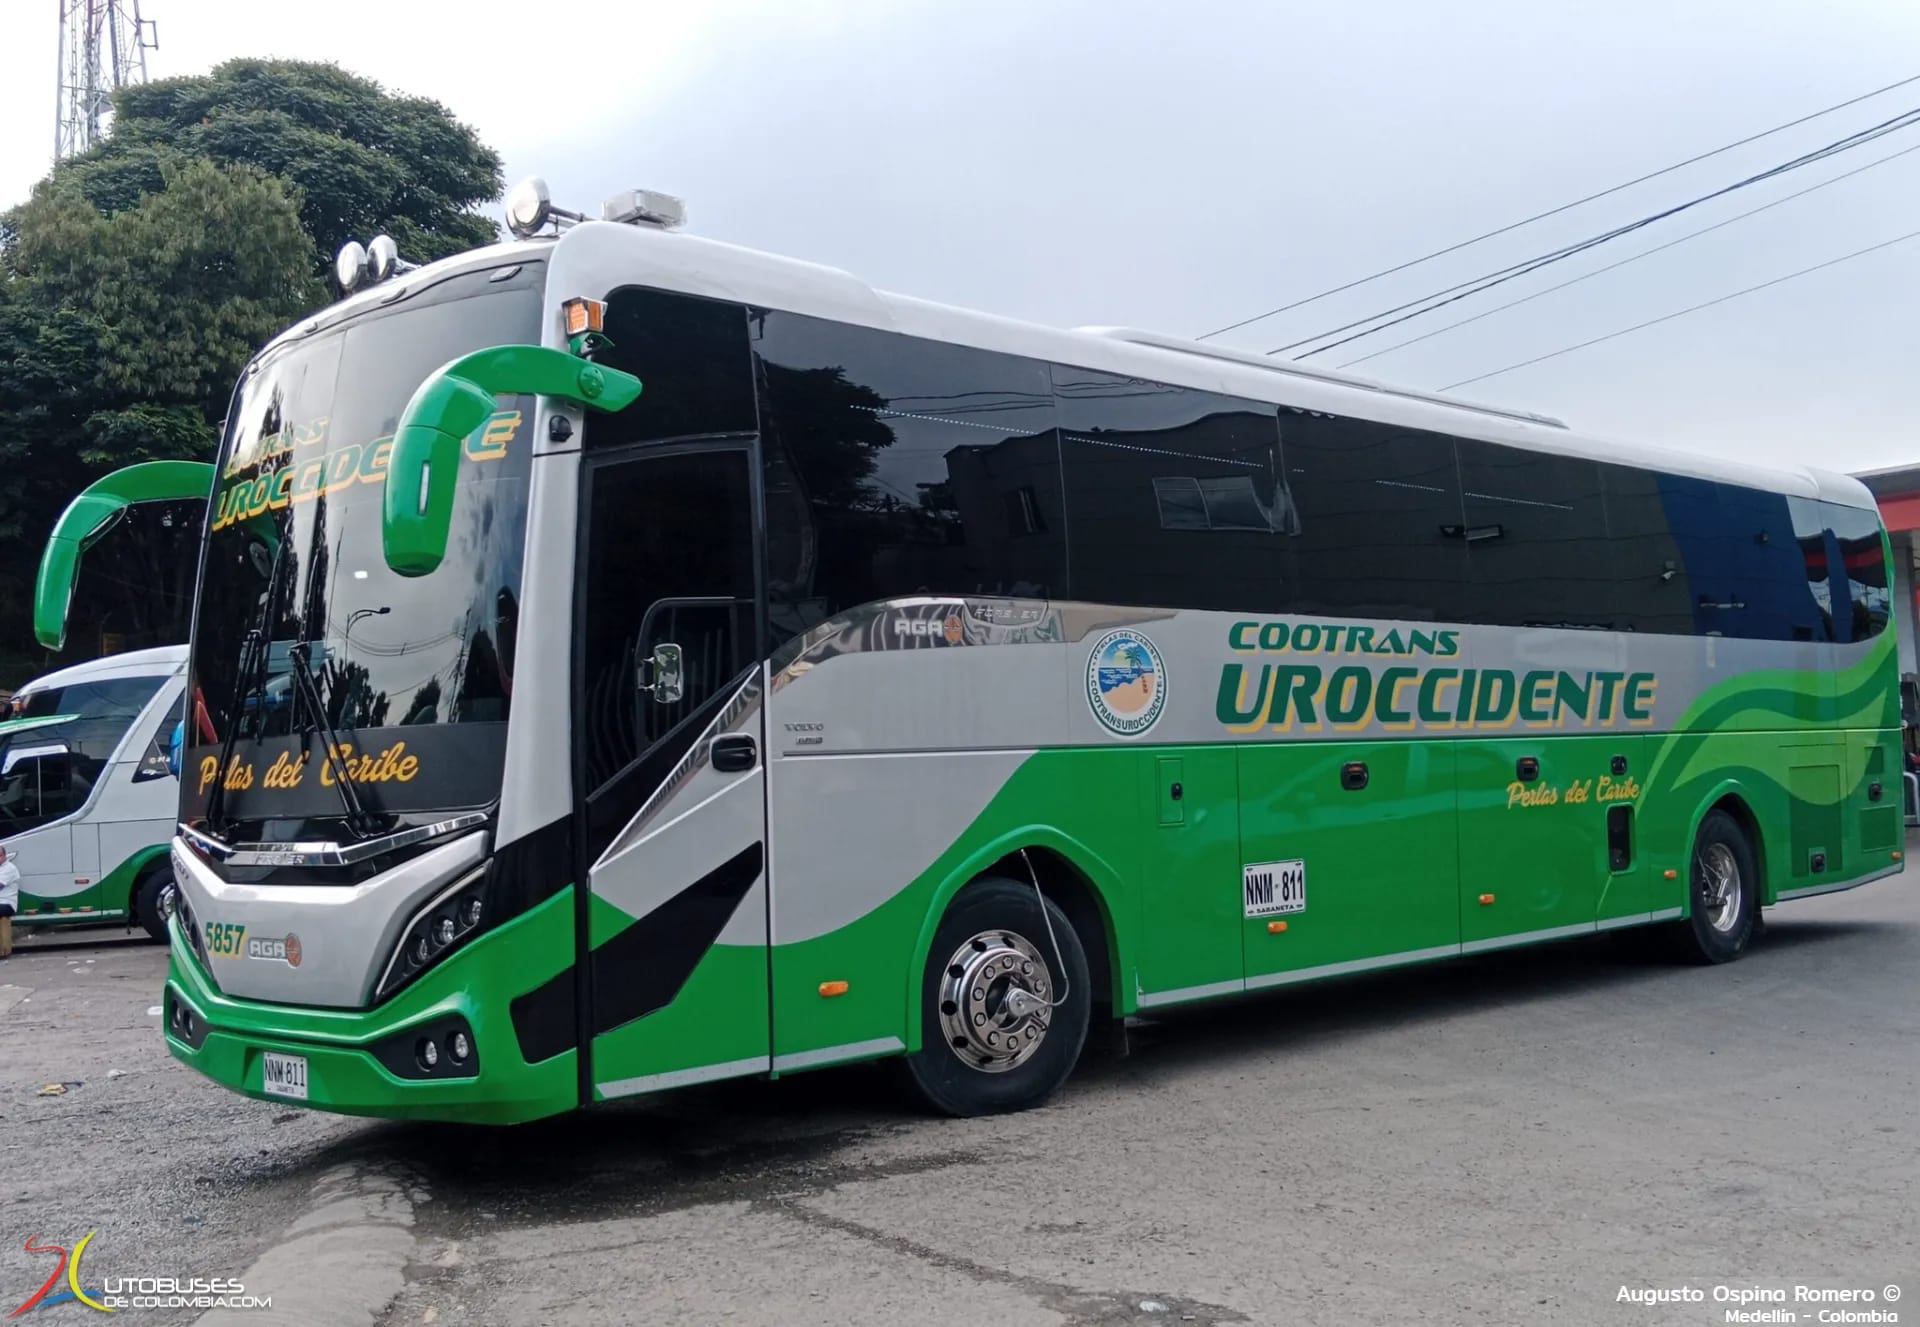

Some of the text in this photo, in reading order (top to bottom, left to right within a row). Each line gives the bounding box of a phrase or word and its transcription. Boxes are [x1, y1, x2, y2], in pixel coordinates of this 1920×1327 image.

[212, 410, 521, 531] UROCCIDEE
[894, 619, 943, 636] AGA
[1229, 621, 1460, 657] COOTRANS
[1091, 679, 1163, 731] COOTRANSUROCCIDENTE
[1216, 663, 1658, 734] UROCCIDENTE
[264, 750, 310, 788] del
[1506, 775, 1640, 810] Perlas del Caribe
[1246, 869, 1303, 906] NNM 811
[1257, 904, 1295, 914] SABANETA
[205, 921, 248, 961] 5857
[249, 940, 287, 958] AGA
[265, 1059, 305, 1087] NNM 811
